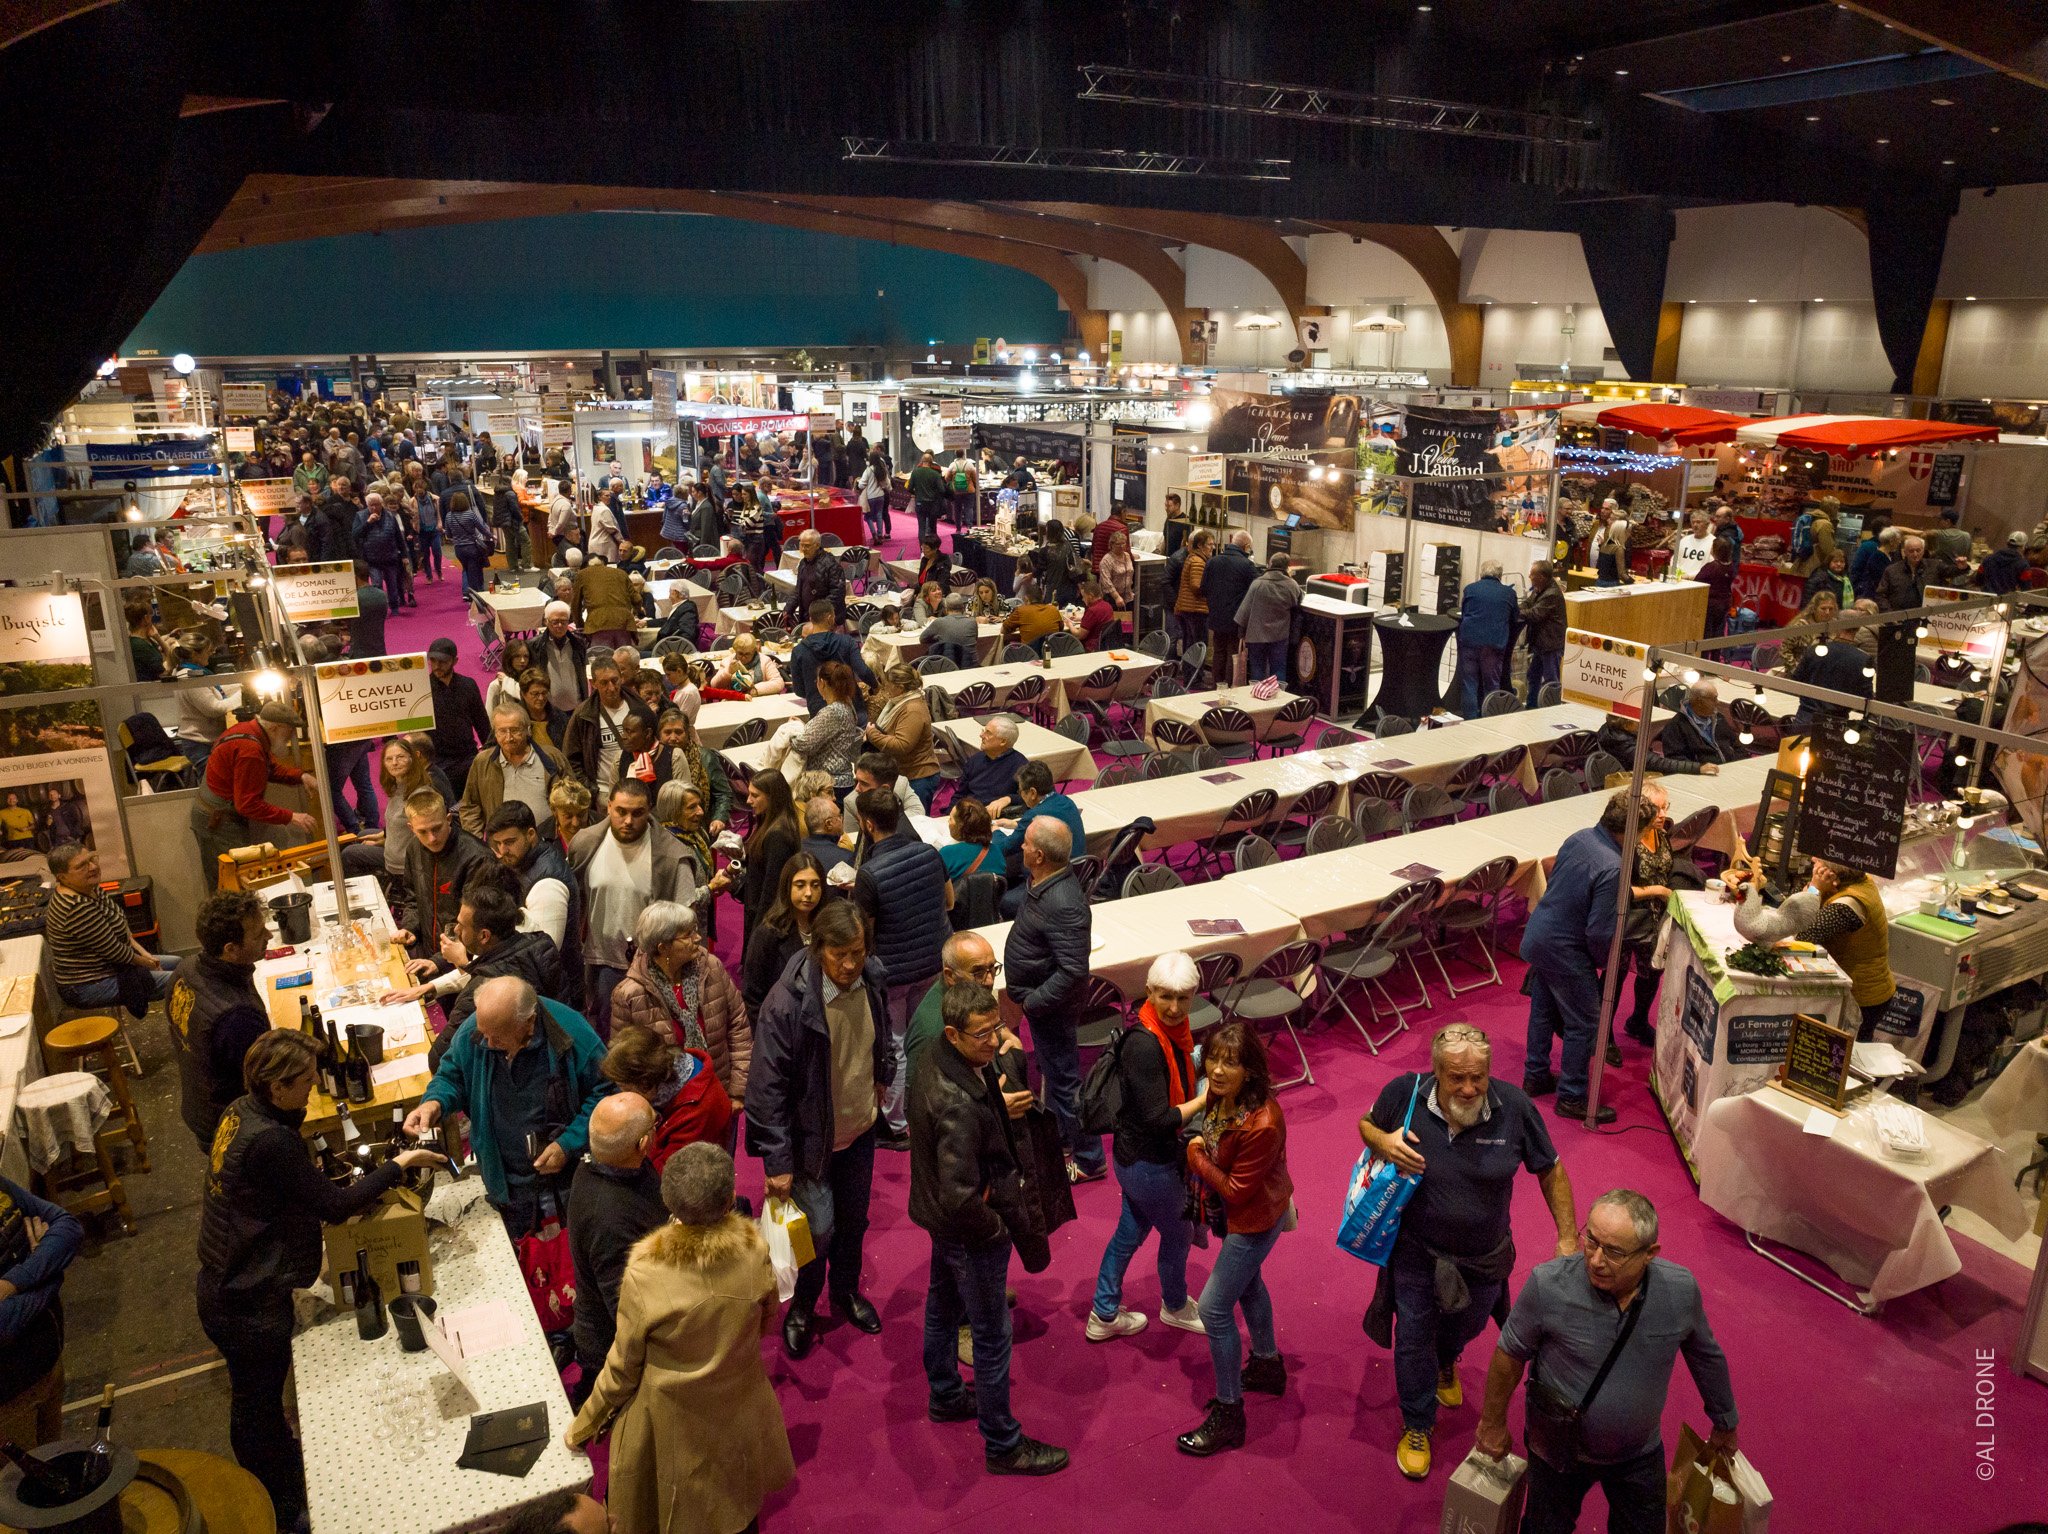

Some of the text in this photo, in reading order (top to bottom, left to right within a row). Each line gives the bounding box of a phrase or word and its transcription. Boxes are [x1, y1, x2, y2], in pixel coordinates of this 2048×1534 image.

[1251, 408, 1314, 421] CHAMPAGNE
[701, 421, 743, 435] POGNES
[746, 420, 759, 431] de
[1258, 421, 1291, 443] Veuve
[1422, 428, 1483, 440] CHAMPAGNE
[134, 452, 153, 460] DES
[1421, 444, 1461, 466] Veuve
[1263, 465, 1292, 475] Depuis 1919
[1408, 453, 1484, 478] J.Lanaud
[1838, 486, 1898, 499] FROMAGES
[1438, 507, 1458, 515] GRAND
[1448, 515, 1471, 523] BLANCS
[1682, 547, 1705, 561] Lee
[296, 579, 337, 588] DOMAINE
[298, 590, 309, 598] LA
[312, 588, 350, 597] BAROTTE
[1931, 620, 1986, 635] BRIONNAIS
[1580, 659, 1627, 679] LA FERME
[1581, 672, 1624, 691] D'ARTUS
[339, 683, 413, 701] LE CAVEAU
[350, 697, 407, 714] BUGISTE
[12, 763, 25, 773] DU
[27, 760, 55, 771] BUGEY
[64, 755, 104, 766] VONGNES
[1824, 843, 1844, 861] Bon
[1733, 1022, 1745, 1030] La
[1748, 1020, 1780, 1029] Ferme
[1351, 1180, 1399, 1249] WWW.JEANLAIN.COM
